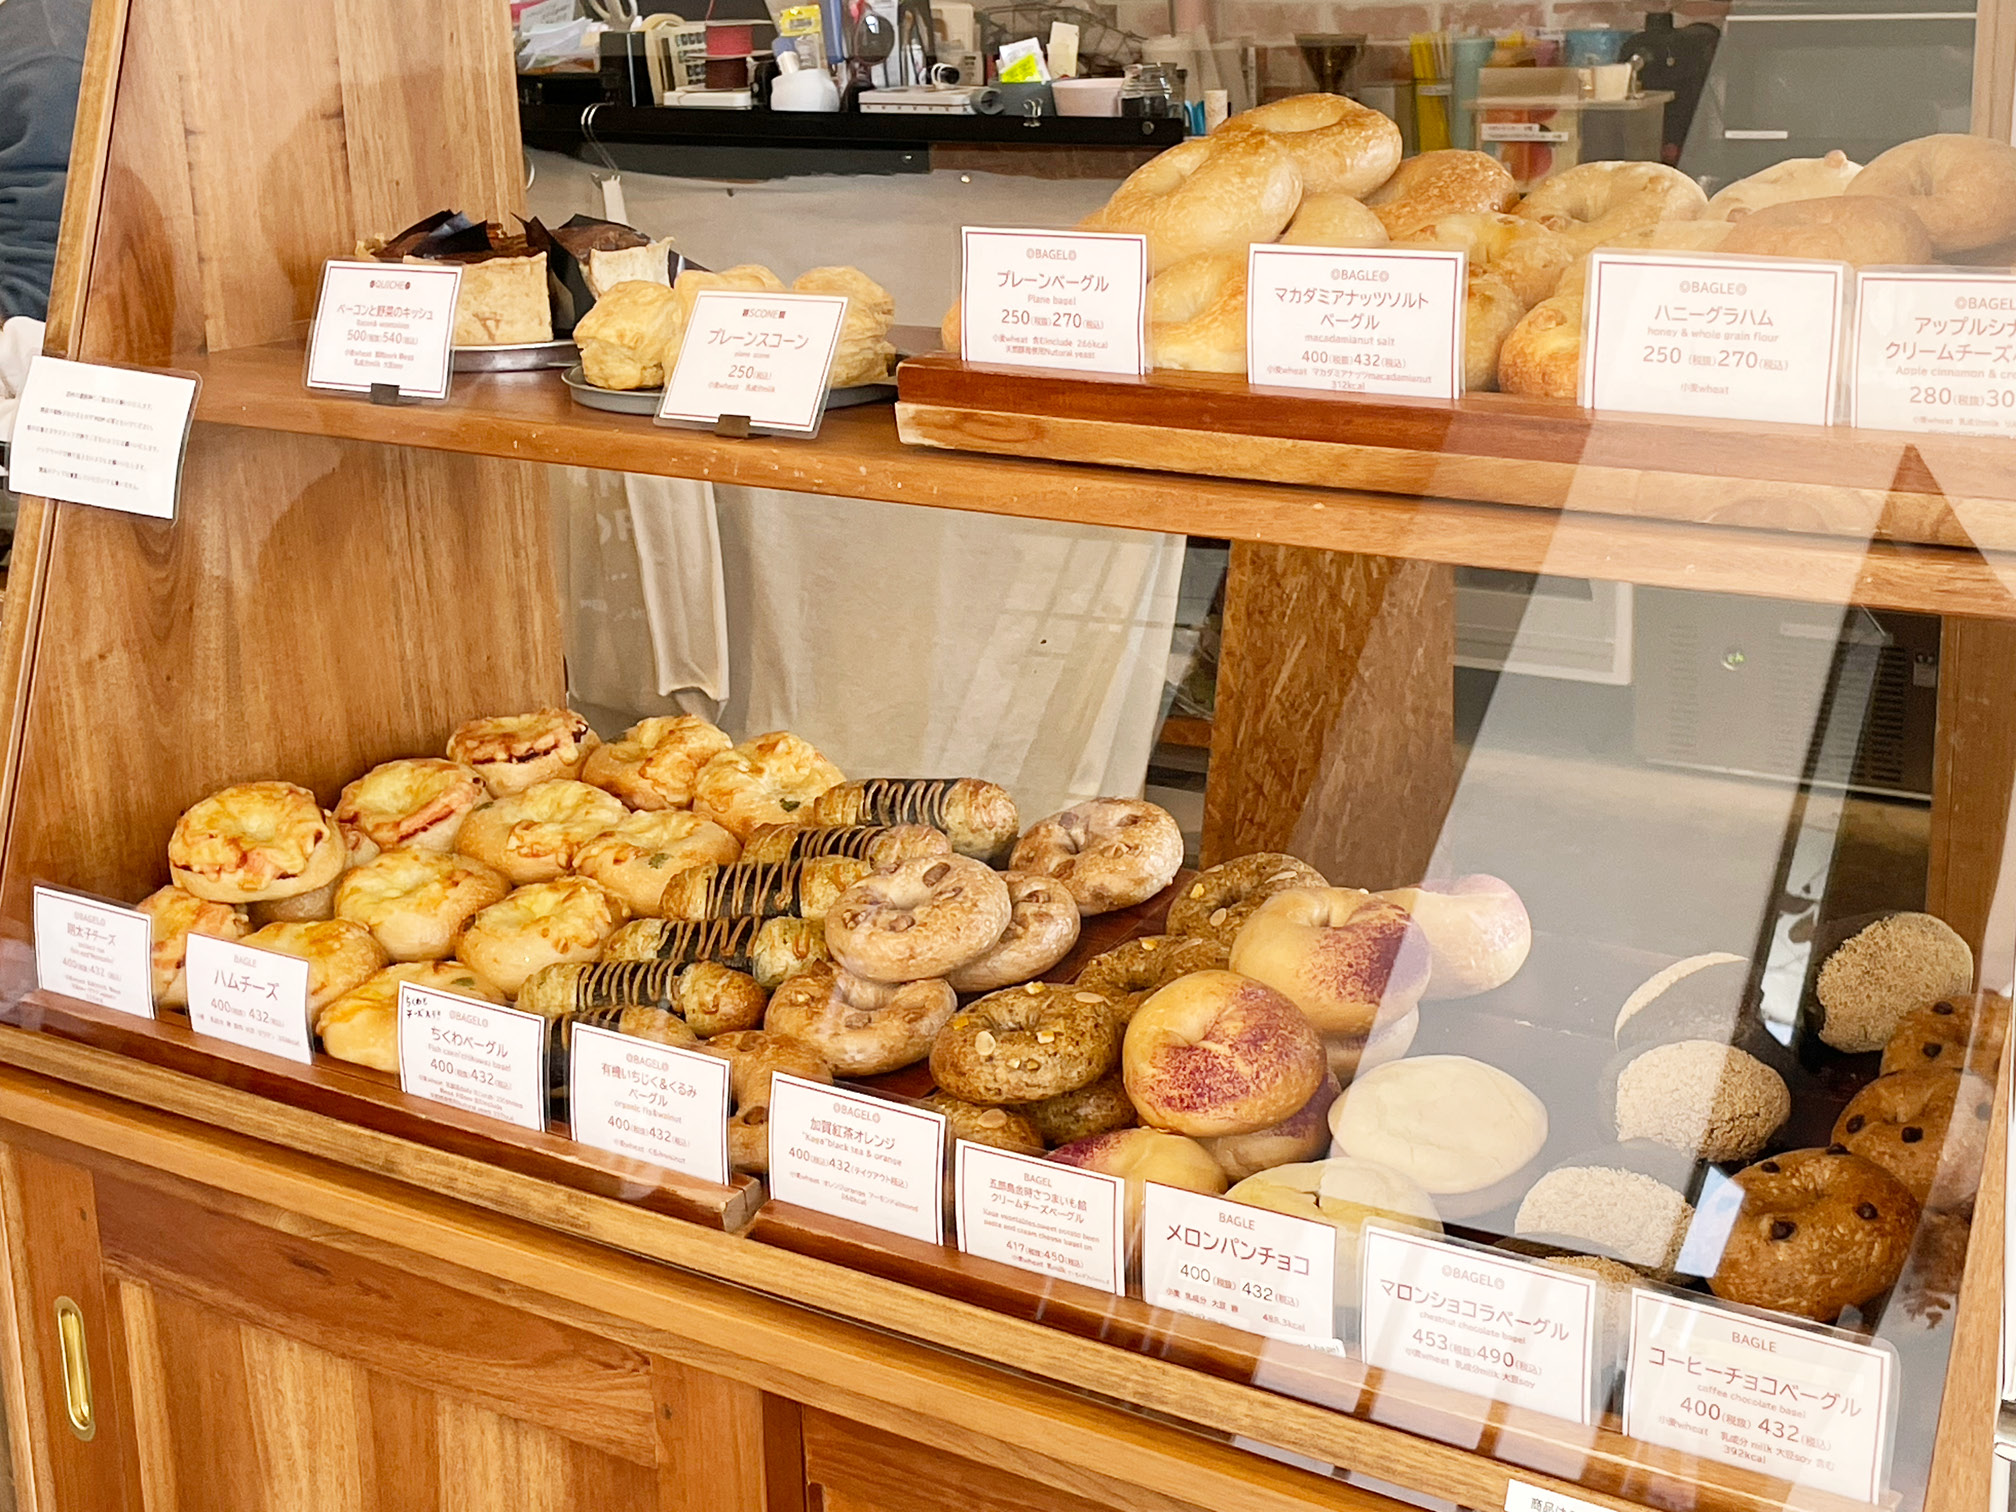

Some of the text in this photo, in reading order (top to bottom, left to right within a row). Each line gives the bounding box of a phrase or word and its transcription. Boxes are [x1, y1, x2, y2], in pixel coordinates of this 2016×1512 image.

[1036, 249, 1068, 260] BAGEL
[998, 271, 1109, 292] プレーンベーグル
[1341, 270, 1379, 281] BAGLE
[1275, 287, 1429, 309] マカダミアナッツソルト
[1691, 281, 1735, 295] BAGLE
[749, 309, 779, 319] SCONE
[1001, 309, 1030, 324] 250
[1052, 312, 1082, 328] 270
[1320, 313, 1380, 330] ベーグル
[1655, 304, 1774, 327] ハニーグラハム
[347, 328, 367, 342] 500
[382, 331, 402, 344] 540
[707, 328, 809, 350] プレーンスコーン
[1647, 326, 1678, 338] honey
[1302, 350, 1328, 364] 400
[1354, 353, 1380, 367] 432
[1643, 345, 1681, 364] 250
[1718, 350, 1758, 368] 270
[1886, 341, 2016, 363] クリームチーズ
[728, 364, 754, 379] 250
[1910, 386, 1951, 404] 280
[214, 970, 279, 1000] ハムチーズ
[211, 998, 231, 1013] 400
[249, 1008, 269, 1024] 432
[431, 1027, 508, 1058] ちくわベーグル
[430, 1058, 453, 1074] 400
[471, 1069, 494, 1086] 432
[628, 1088, 668, 1107] ベーグル
[841, 1103, 873, 1121] BAGEL
[608, 1115, 630, 1131] 400
[649, 1127, 671, 1143] 432
[789, 1147, 810, 1162] 400
[829, 1158, 850, 1173] 432
[1024, 1173, 1052, 1188] BAGEL
[991, 1193, 1085, 1224] クリームチーズベーグル
[1219, 1212, 1255, 1231] BAGLE
[1006, 1240, 1024, 1252] 417
[1167, 1224, 1310, 1276] メロンパンチョコ
[1180, 1264, 1211, 1282] 400
[1242, 1282, 1273, 1301] 432
[1452, 1267, 1494, 1287] BAGEL
[1380, 1278, 1569, 1341] マロンショコラベーグル
[1412, 1328, 1448, 1350] 453
[1477, 1345, 1514, 1368] 490
[1732, 1331, 1777, 1353] BAGLE
[1649, 1346, 1862, 1418] コーヒーチョコベーグル
[1680, 1397, 1720, 1421] 400
[1758, 1418, 1799, 1443] 432
